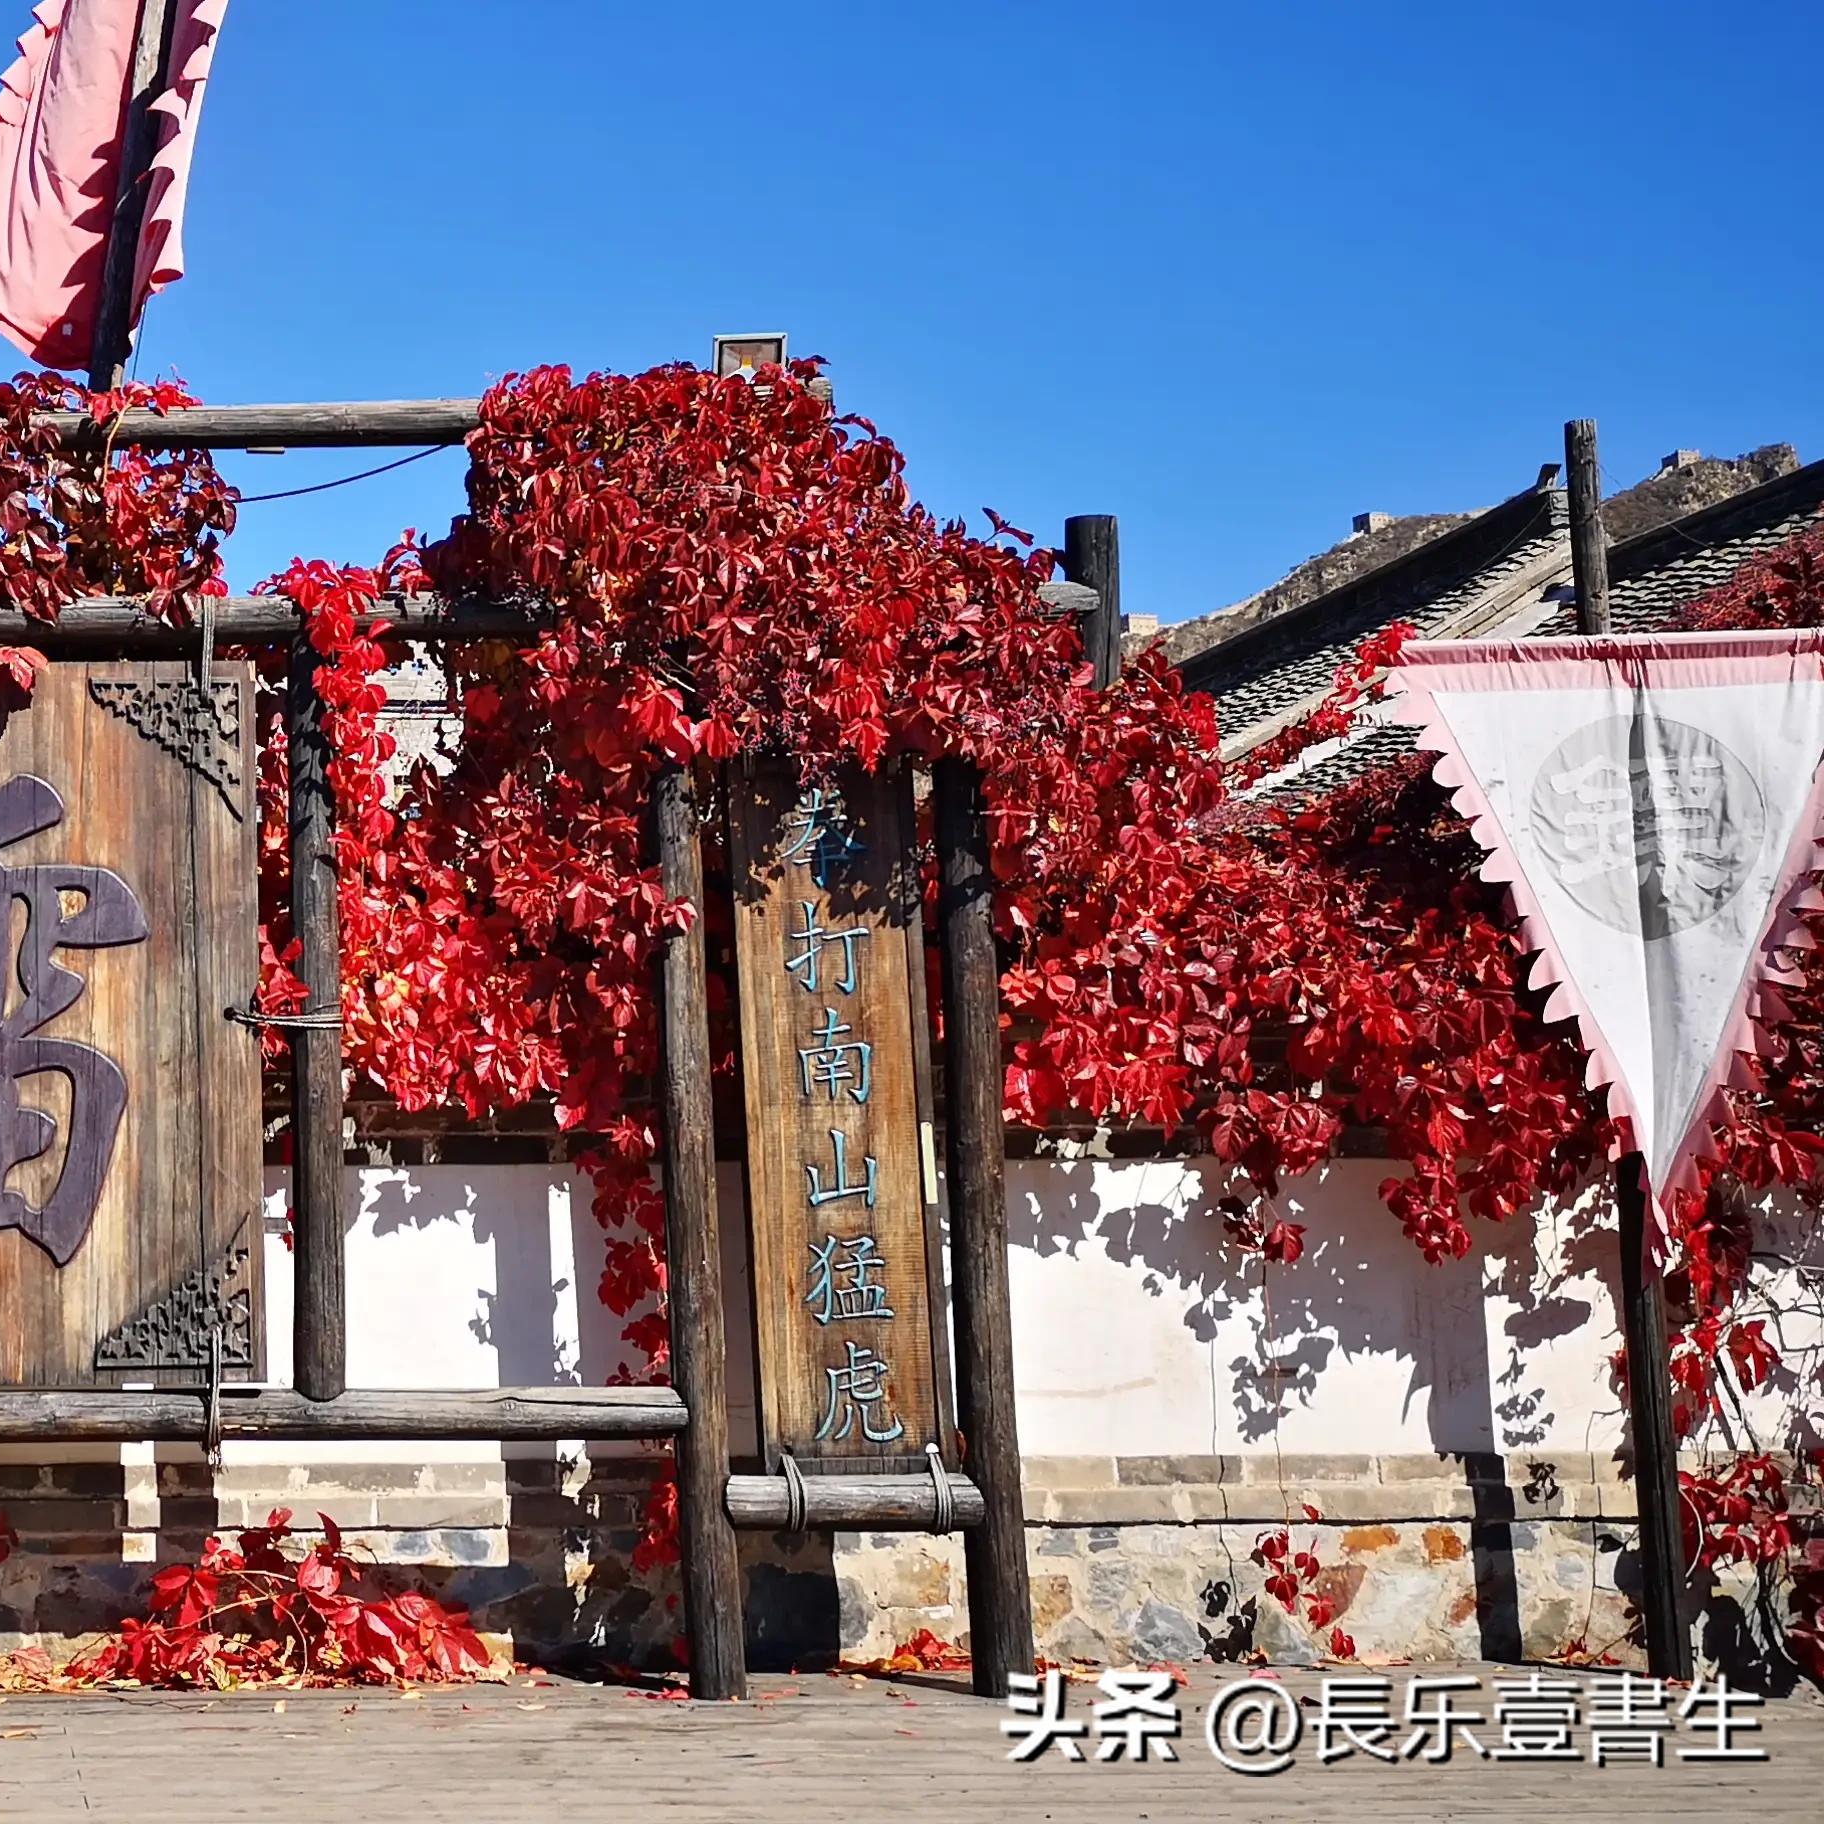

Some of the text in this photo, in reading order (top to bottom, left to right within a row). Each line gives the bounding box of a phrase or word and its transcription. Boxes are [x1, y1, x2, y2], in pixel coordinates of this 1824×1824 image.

[781, 786, 903, 1443] 拳打南山猛虎
